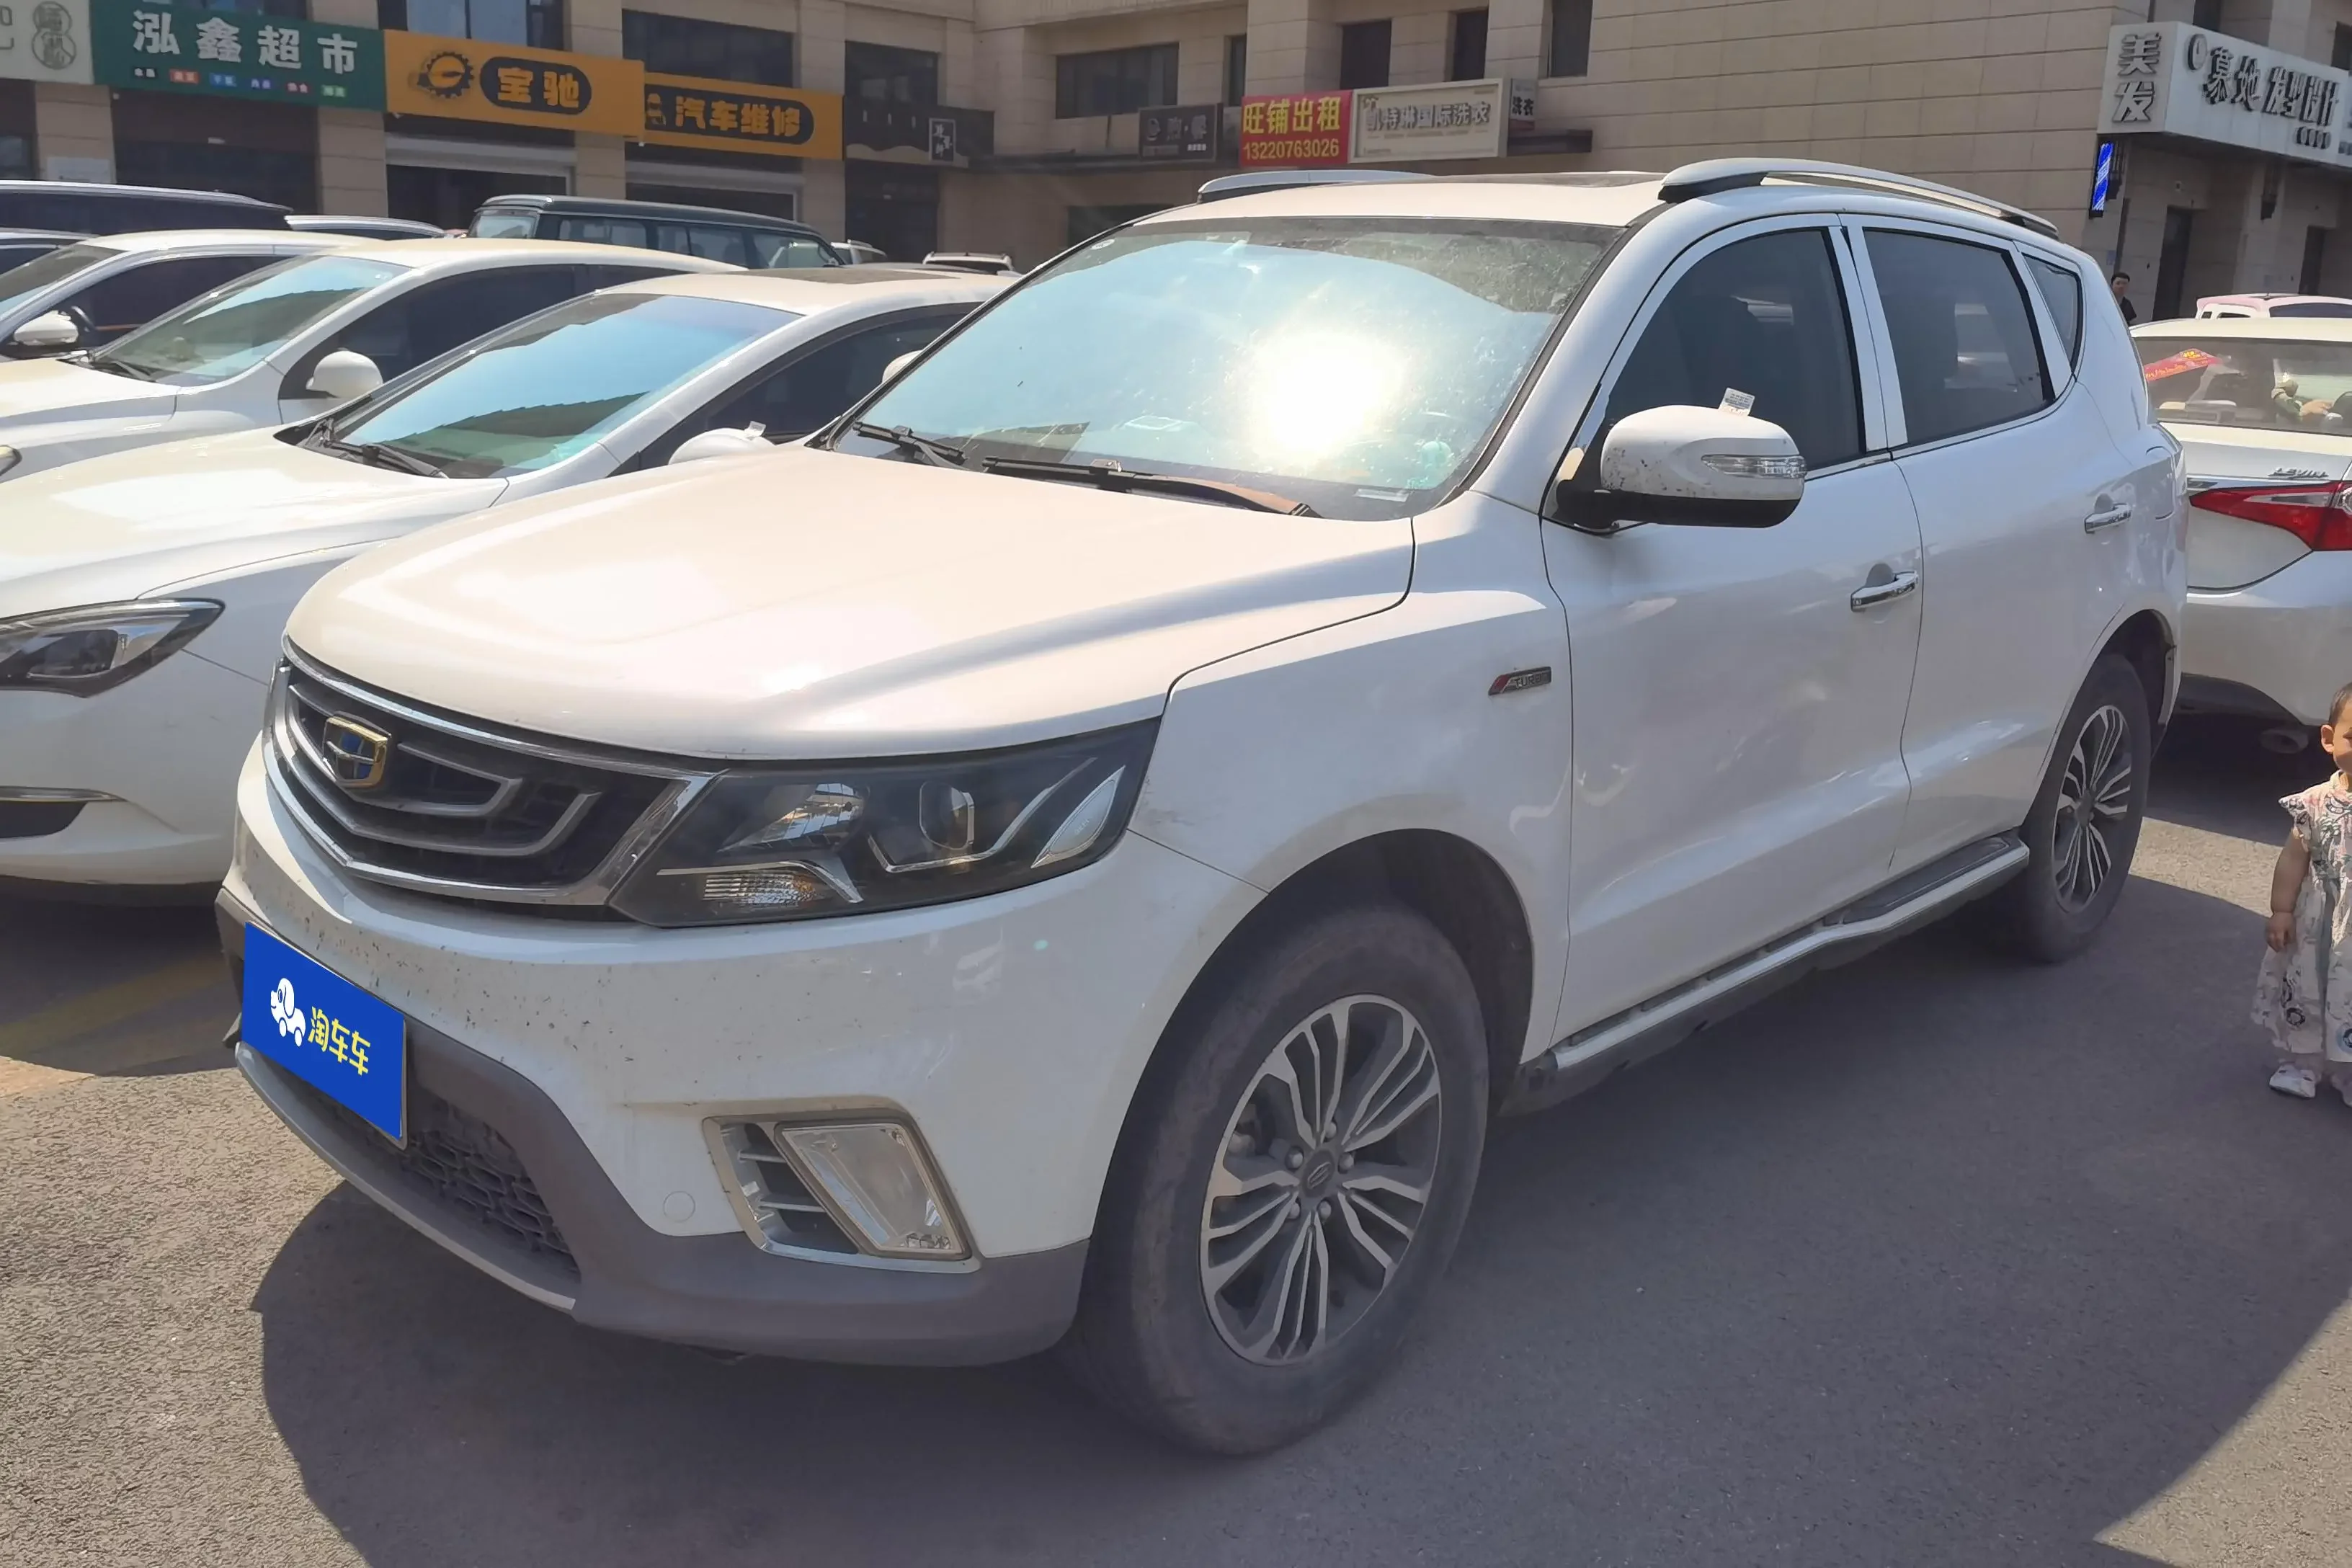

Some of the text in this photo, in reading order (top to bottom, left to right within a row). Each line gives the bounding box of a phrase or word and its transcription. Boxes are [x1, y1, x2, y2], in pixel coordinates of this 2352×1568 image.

[132, 9, 359, 74] 泓鑫超市
[497, 67, 579, 108] 宝驰
[2112, 32, 2162, 123] 美发
[1243, 97, 1341, 135] 旺铺出租
[1243, 138, 1340, 160] 13220763026
